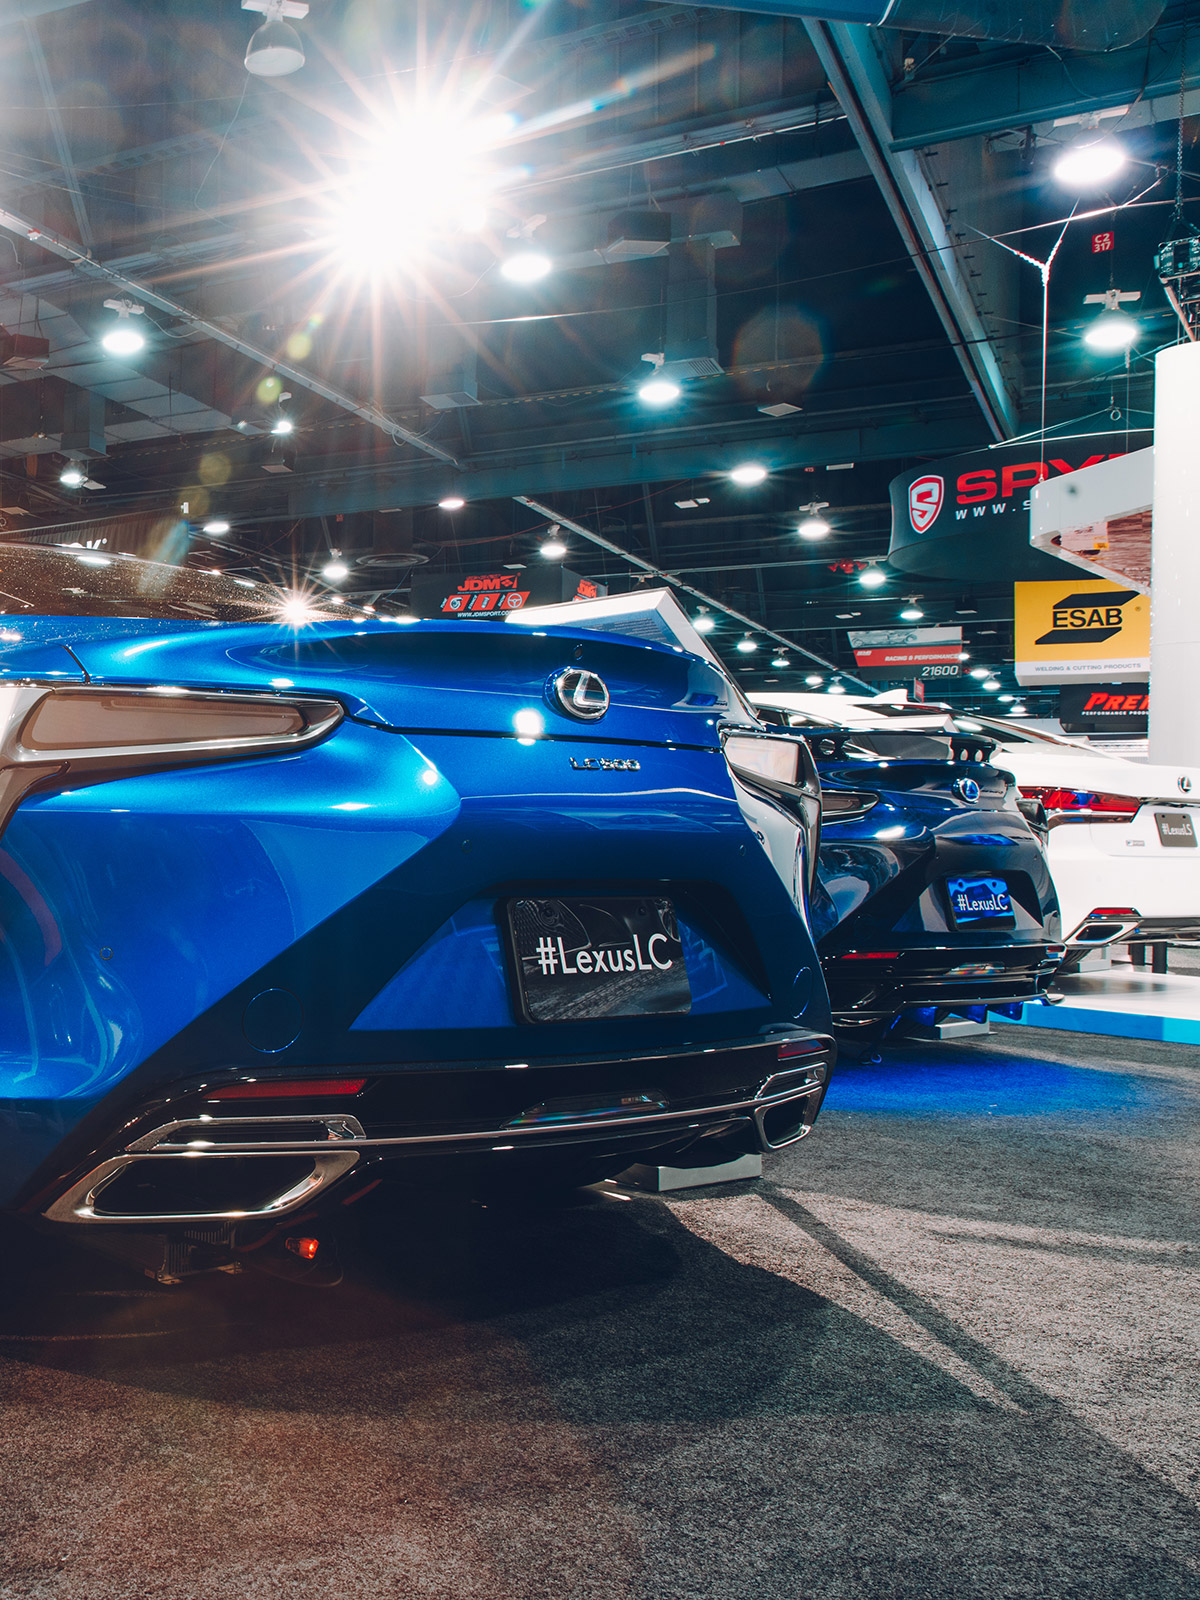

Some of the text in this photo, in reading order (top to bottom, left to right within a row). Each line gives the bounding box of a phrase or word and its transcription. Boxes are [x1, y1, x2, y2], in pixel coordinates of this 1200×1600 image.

[1094, 233, 1110, 243] C2
[1094, 242, 1111, 253] 317
[956, 452, 1129, 505] SPY
[457, 578, 501, 591] JDM
[1052, 608, 1123, 628] ESAB
[921, 665, 960, 676] 21600
[957, 894, 1008, 911] #LexusLC
[536, 933, 673, 975] #LexusLC
